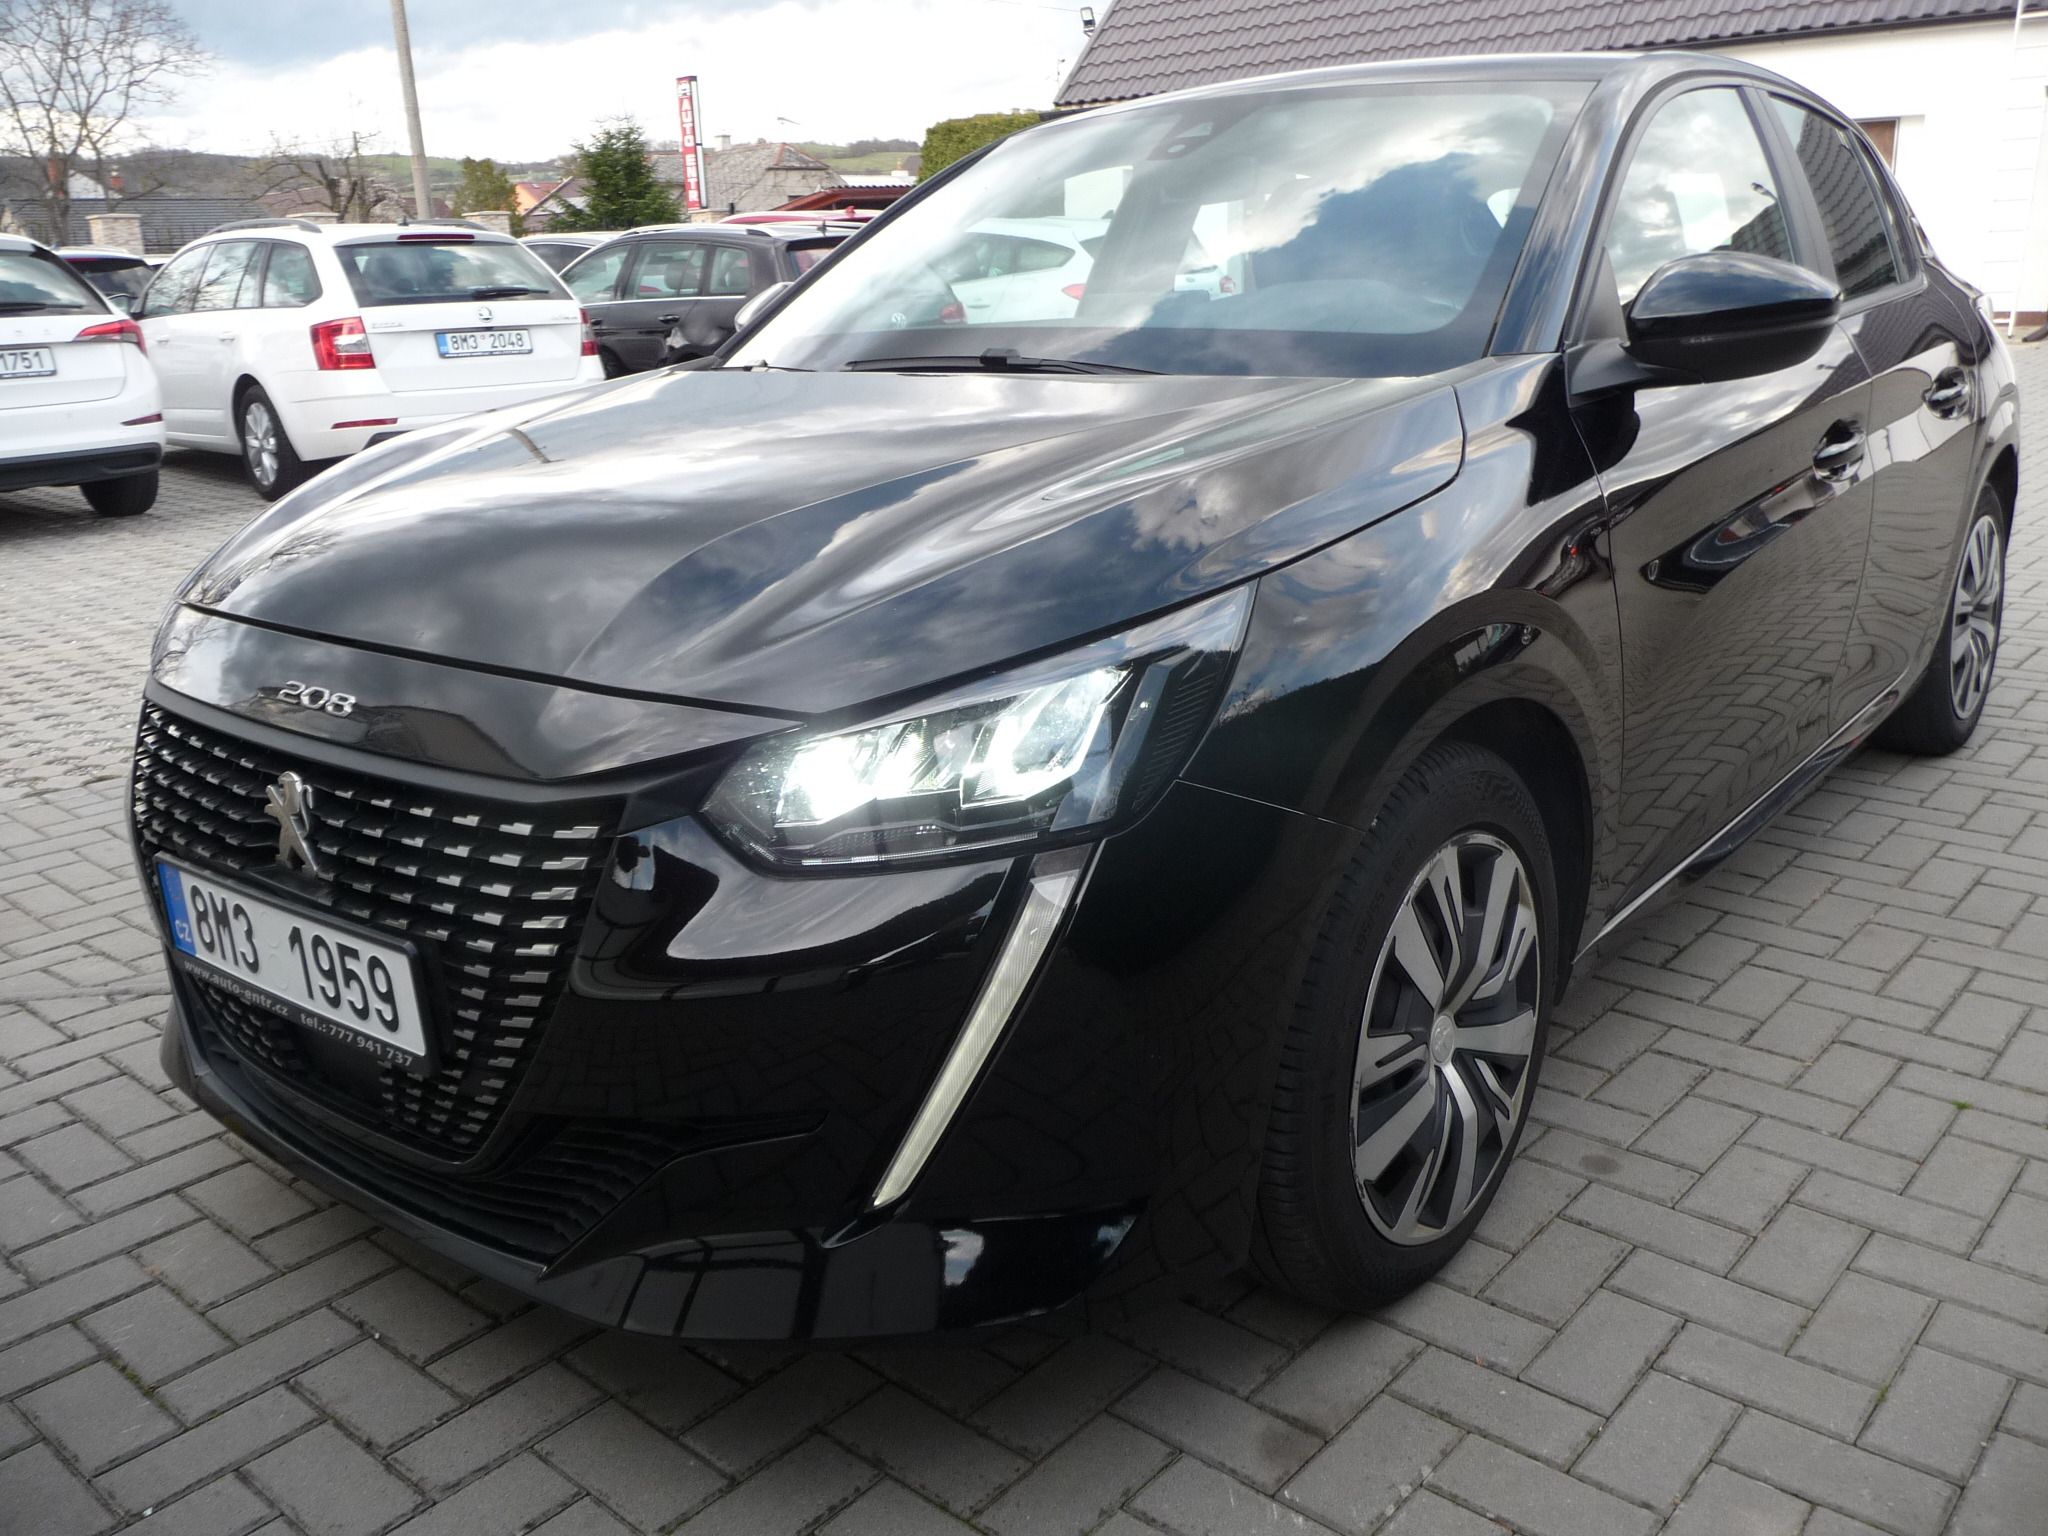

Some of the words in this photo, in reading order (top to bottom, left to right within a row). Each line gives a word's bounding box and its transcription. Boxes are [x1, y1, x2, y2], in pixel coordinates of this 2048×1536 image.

[681, 98, 694, 147] AUTO
[685, 153, 699, 201] ENTR
[0, 351, 44, 371] 1751
[450, 334, 478, 351] 8M3
[489, 332, 524, 349] 2048
[276, 681, 356, 718] 208
[175, 919, 193, 943] CZ
[190, 884, 260, 974] 8M3
[288, 926, 399, 1033] 1959
[183, 959, 289, 1017] www.auto-entr.cz
[356, 1036, 382, 1055] 941
[386, 1047, 412, 1067] 737
